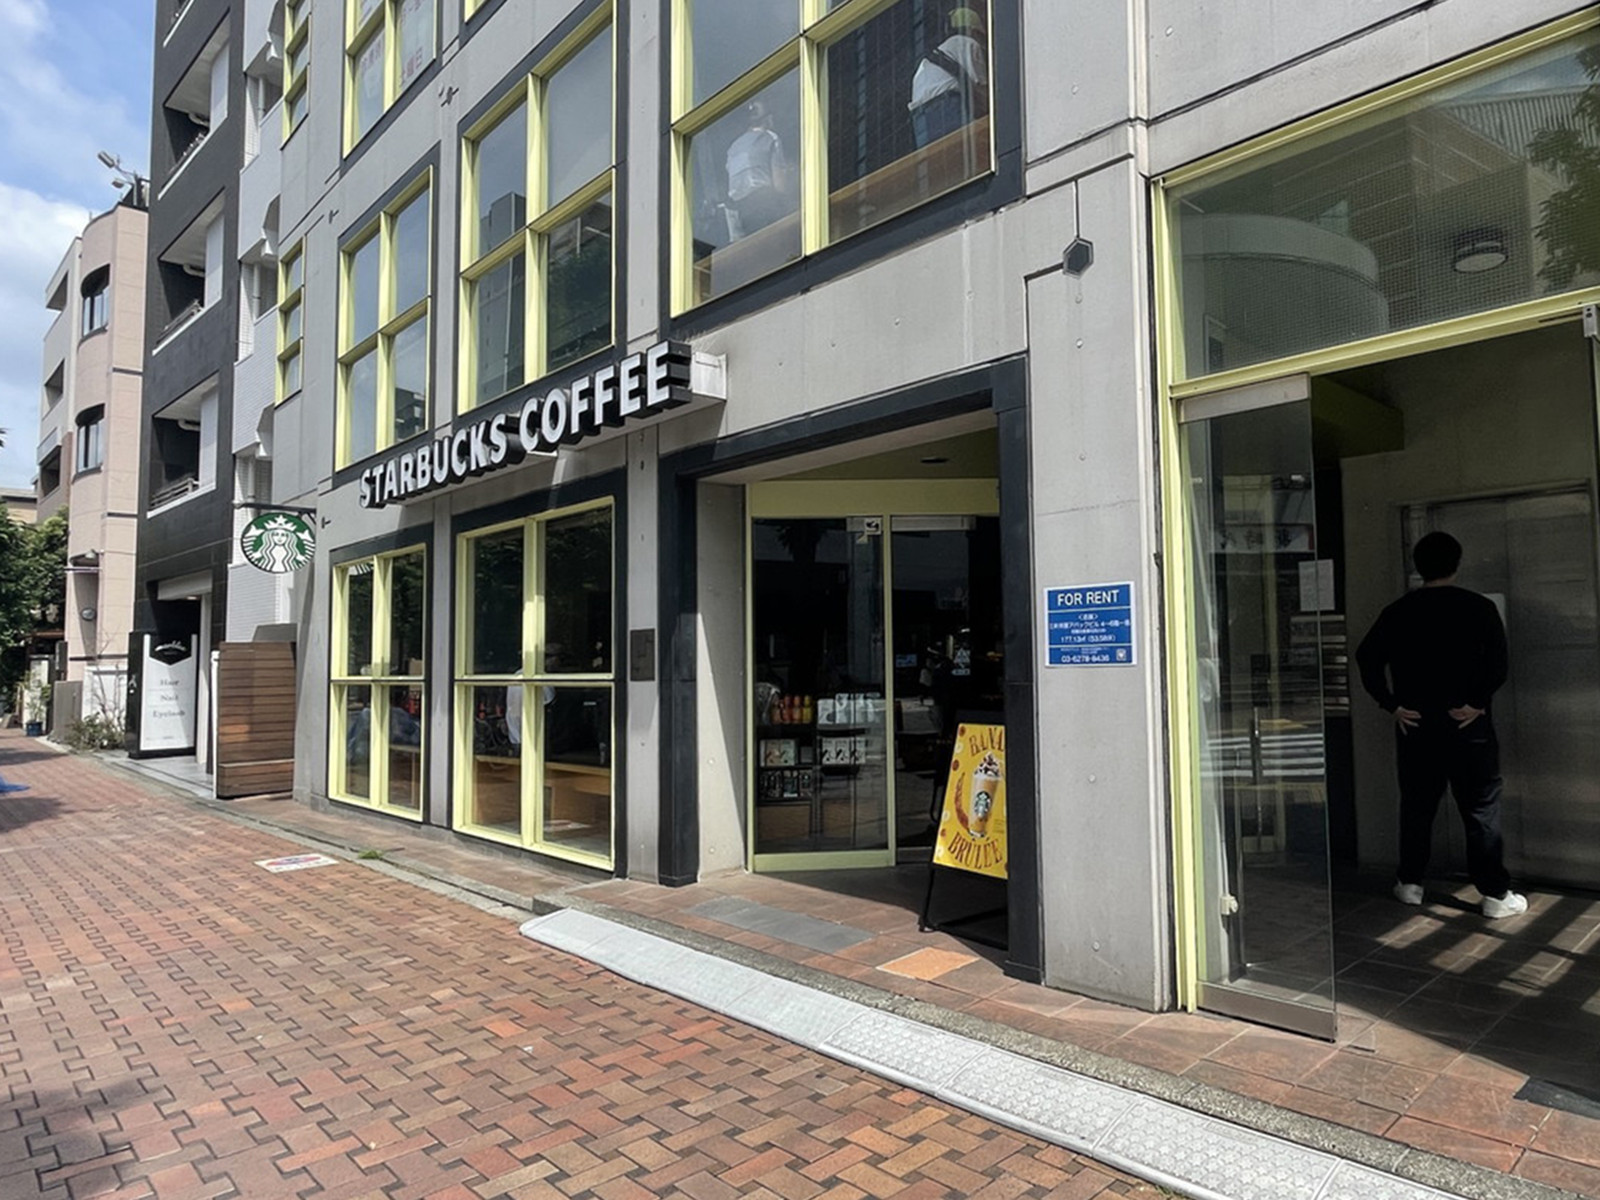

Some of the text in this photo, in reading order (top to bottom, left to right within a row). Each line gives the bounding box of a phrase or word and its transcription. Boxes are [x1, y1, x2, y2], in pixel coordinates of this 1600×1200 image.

[359, 339, 672, 507] STARBUCKS COFFEE
[1058, 590, 1119, 606] FOR RENT
